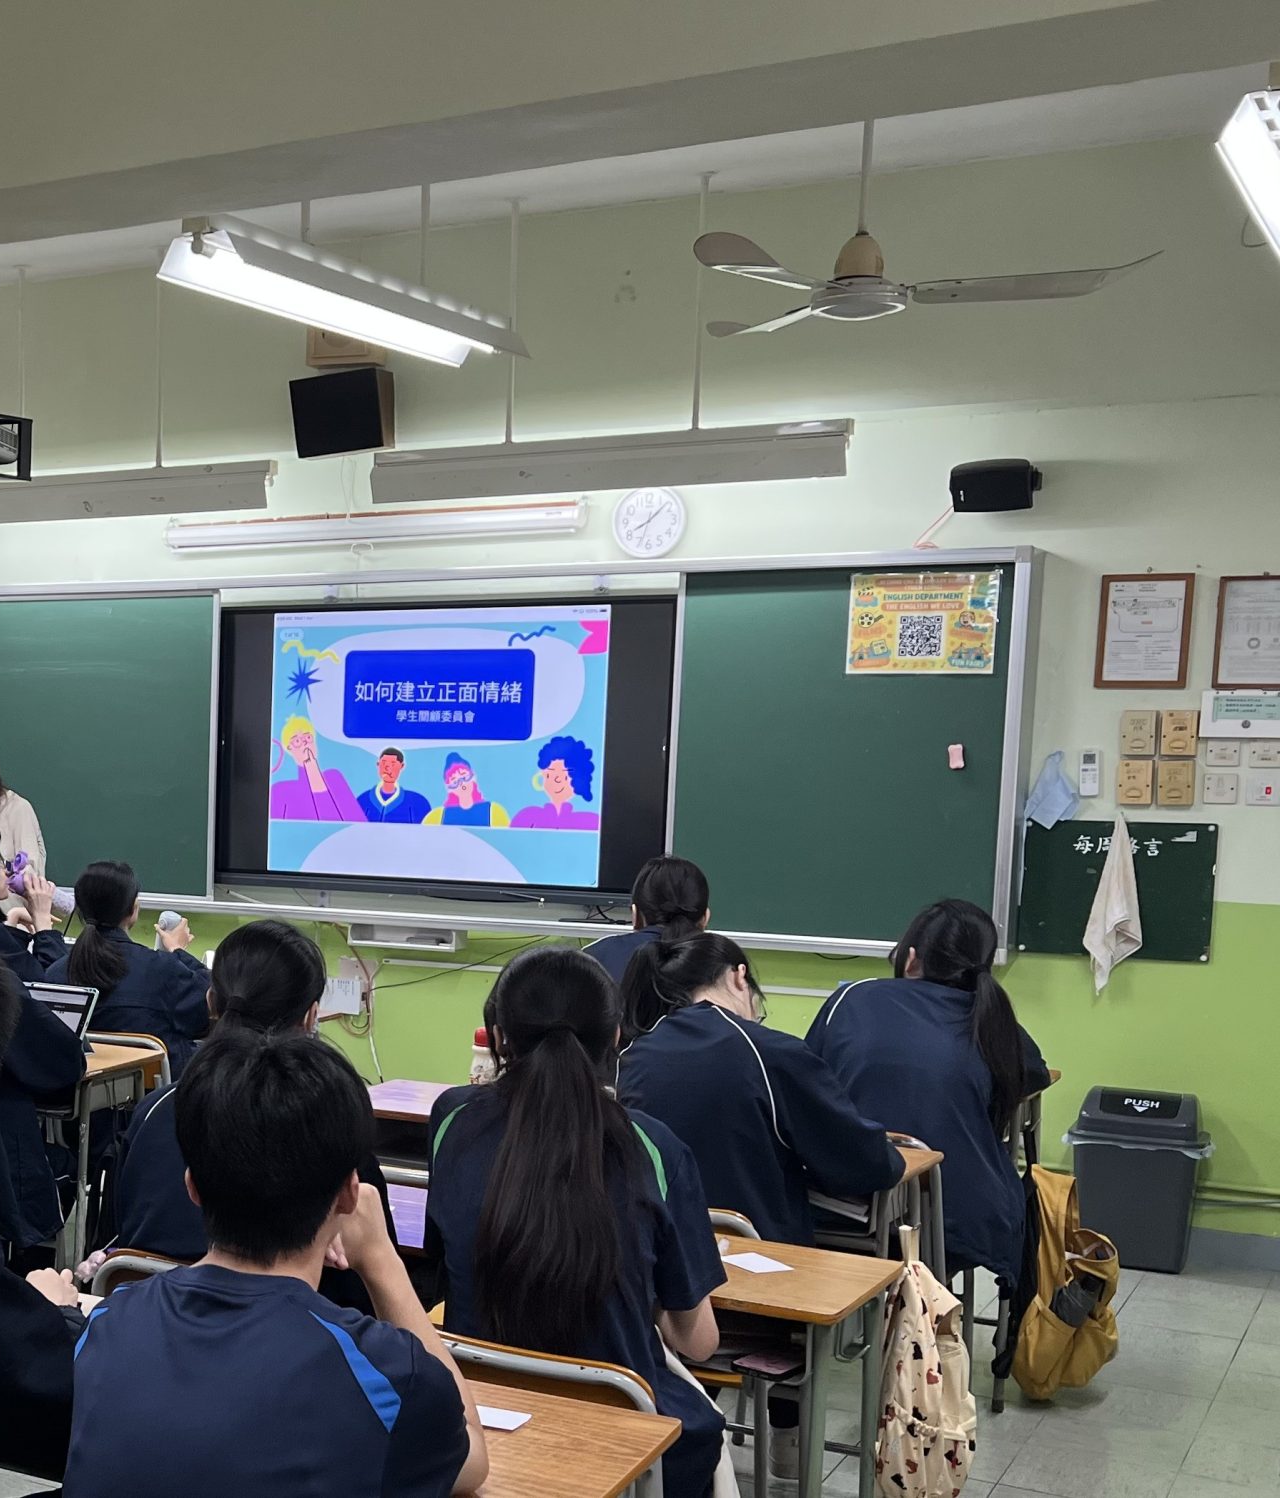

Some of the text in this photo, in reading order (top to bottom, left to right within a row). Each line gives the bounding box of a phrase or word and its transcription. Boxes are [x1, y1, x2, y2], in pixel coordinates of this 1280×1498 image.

[626, 505, 636, 516] 10
[665, 501, 673, 512] 2
[622, 518, 629, 528] 9
[670, 514, 677, 525] 3
[626, 530, 632, 541] 8
[665, 528, 672, 538] 4
[644, 539, 652, 550] 6
[656, 535, 663, 547] 5
[915, 592, 964, 600] DEPARTMENT
[354, 680, 523, 704] 如何建立正面情緒
[396, 709, 475, 723] 學生關顧委員會
[1124, 1098, 1160, 1109] PUSH
